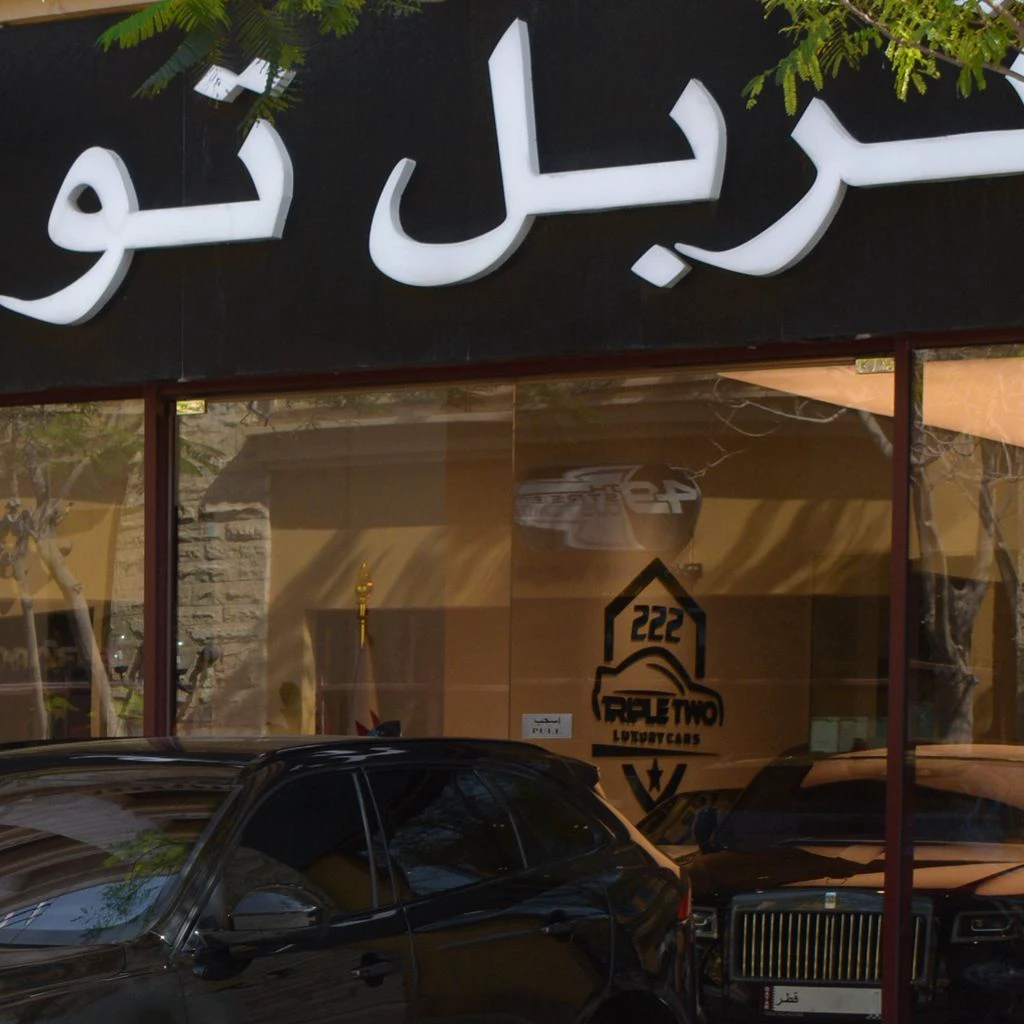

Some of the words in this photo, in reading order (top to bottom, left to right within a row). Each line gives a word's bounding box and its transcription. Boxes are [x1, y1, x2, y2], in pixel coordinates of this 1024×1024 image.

[367, 17, 1024, 290] ربل
[631, 604, 684, 643] 222
[671, 699, 719, 727] TWO
[612, 729, 665, 744] LUXURY
[666, 732, 701, 745] CARS
[775, 991, 799, 1006] قطر
